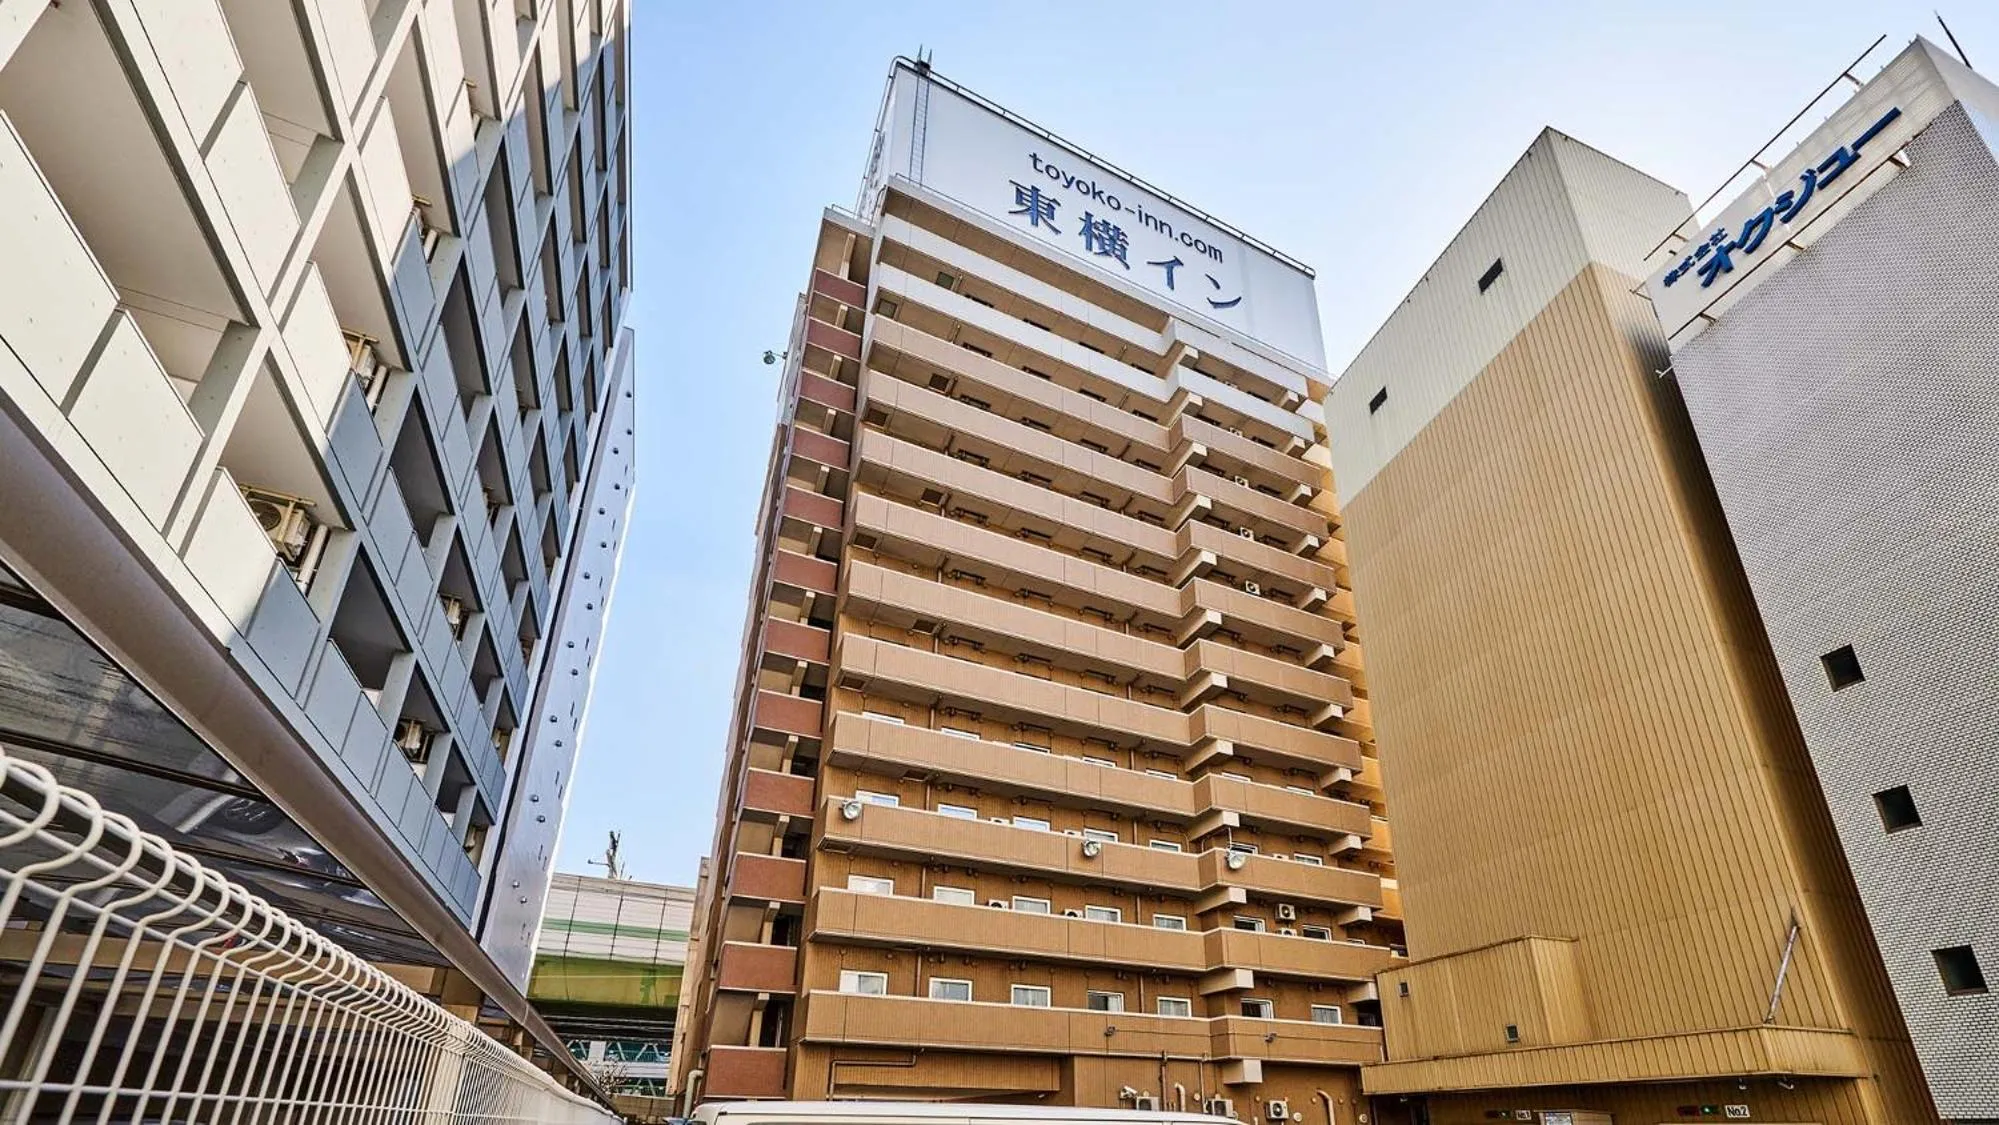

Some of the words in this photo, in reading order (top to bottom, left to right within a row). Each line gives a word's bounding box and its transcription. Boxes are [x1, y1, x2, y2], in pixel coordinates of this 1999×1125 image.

[1008, 179, 1242, 309] 東横イン
[1029, 152, 1223, 263] toyoko-inn.com
